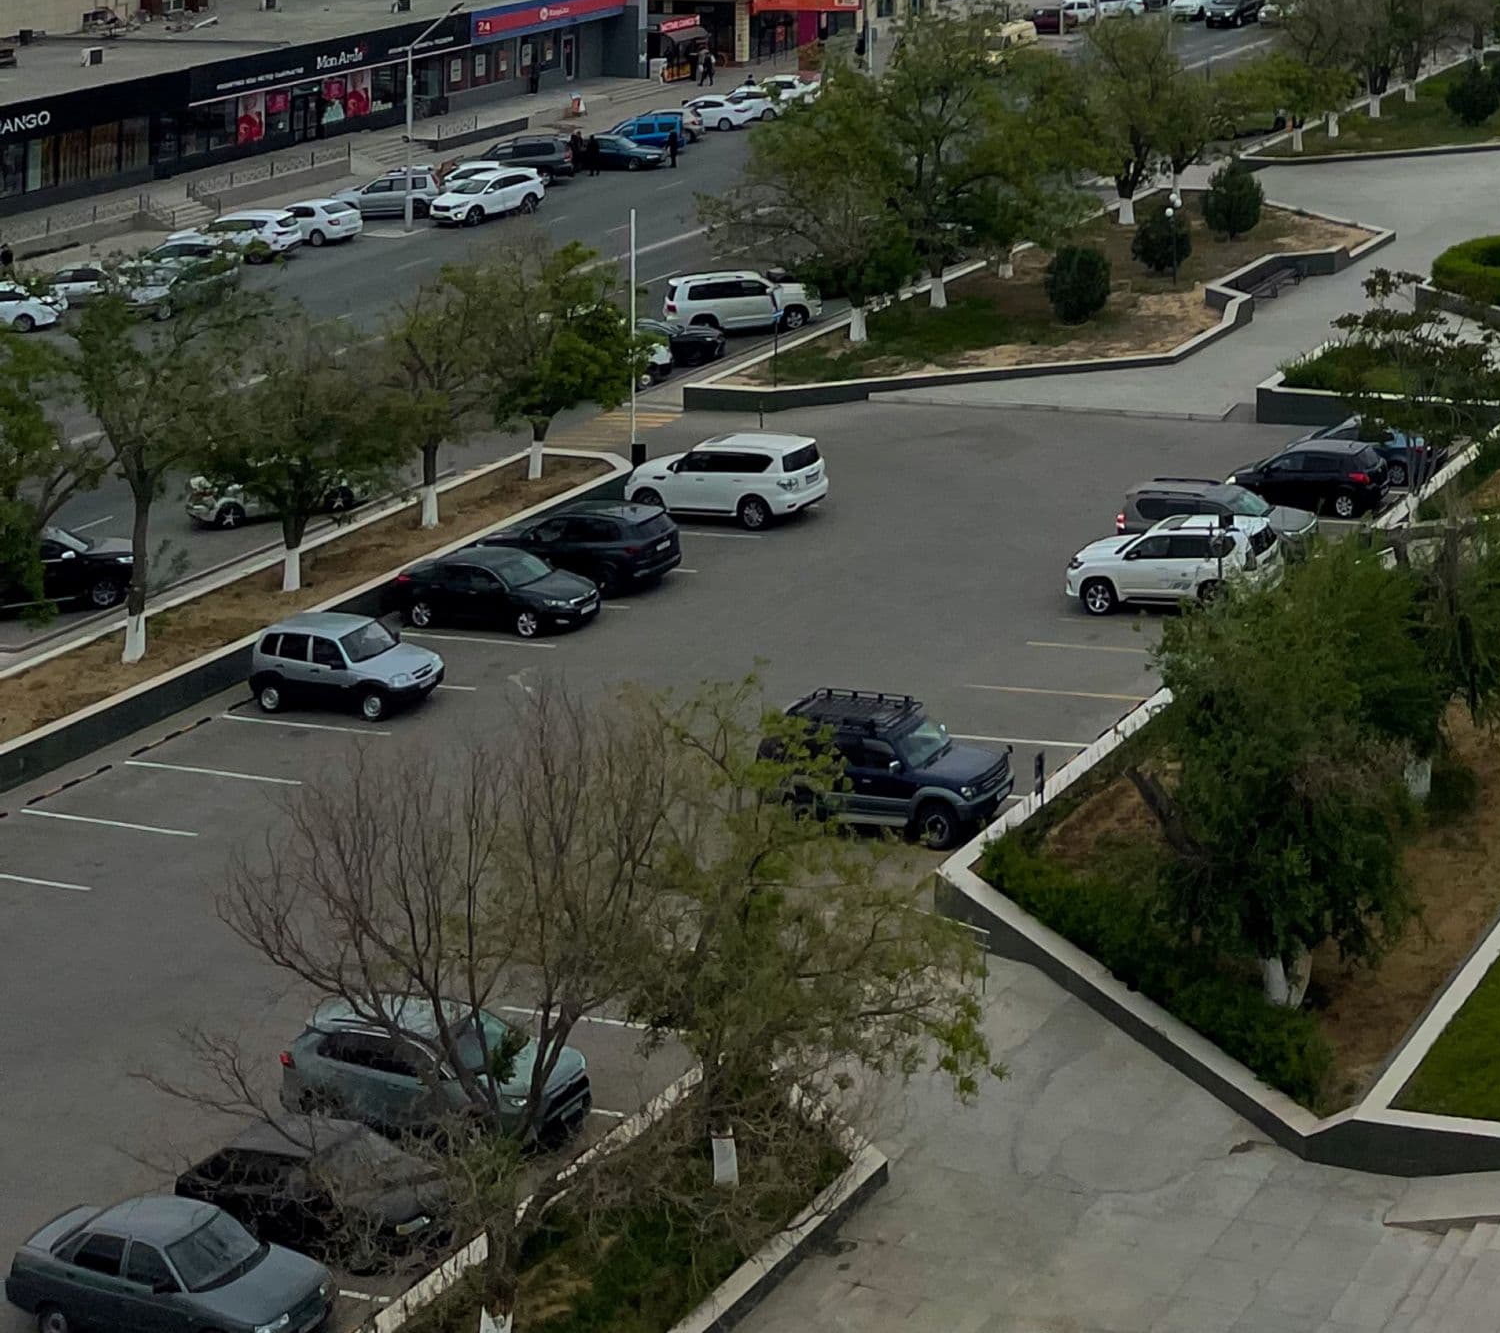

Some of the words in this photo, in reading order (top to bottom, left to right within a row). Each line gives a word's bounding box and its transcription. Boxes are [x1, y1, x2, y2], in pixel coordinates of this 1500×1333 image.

[478, 21, 491, 31] 24
[316, 55, 338, 70] Mon
[0, 110, 51, 135] ANGO
